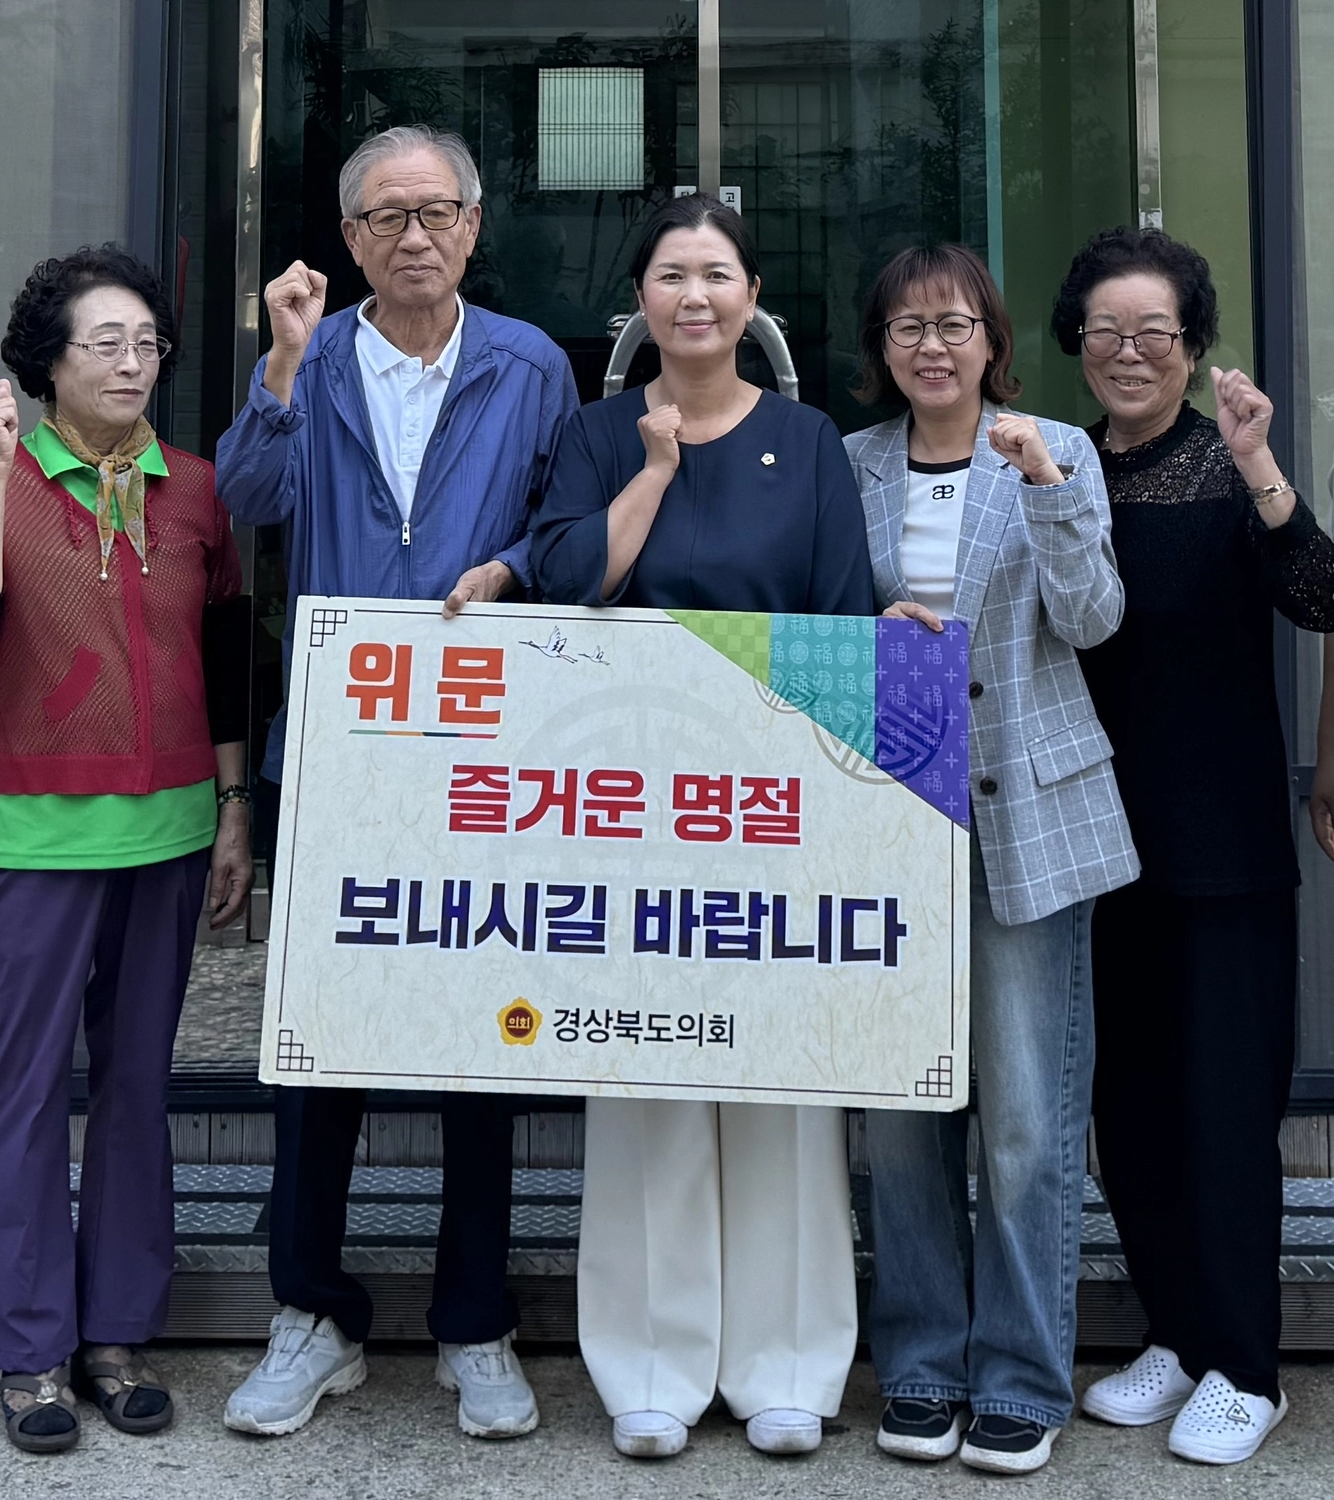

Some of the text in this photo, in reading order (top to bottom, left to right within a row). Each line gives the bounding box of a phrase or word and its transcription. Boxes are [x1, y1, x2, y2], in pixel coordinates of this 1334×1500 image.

[448, 764, 801, 846] 즐거운 명절
[334, 875, 908, 968] 보내시길 바랍니다
[507, 1016, 531, 1030] 의회
[552, 1007, 735, 1050] 경상북도의회
